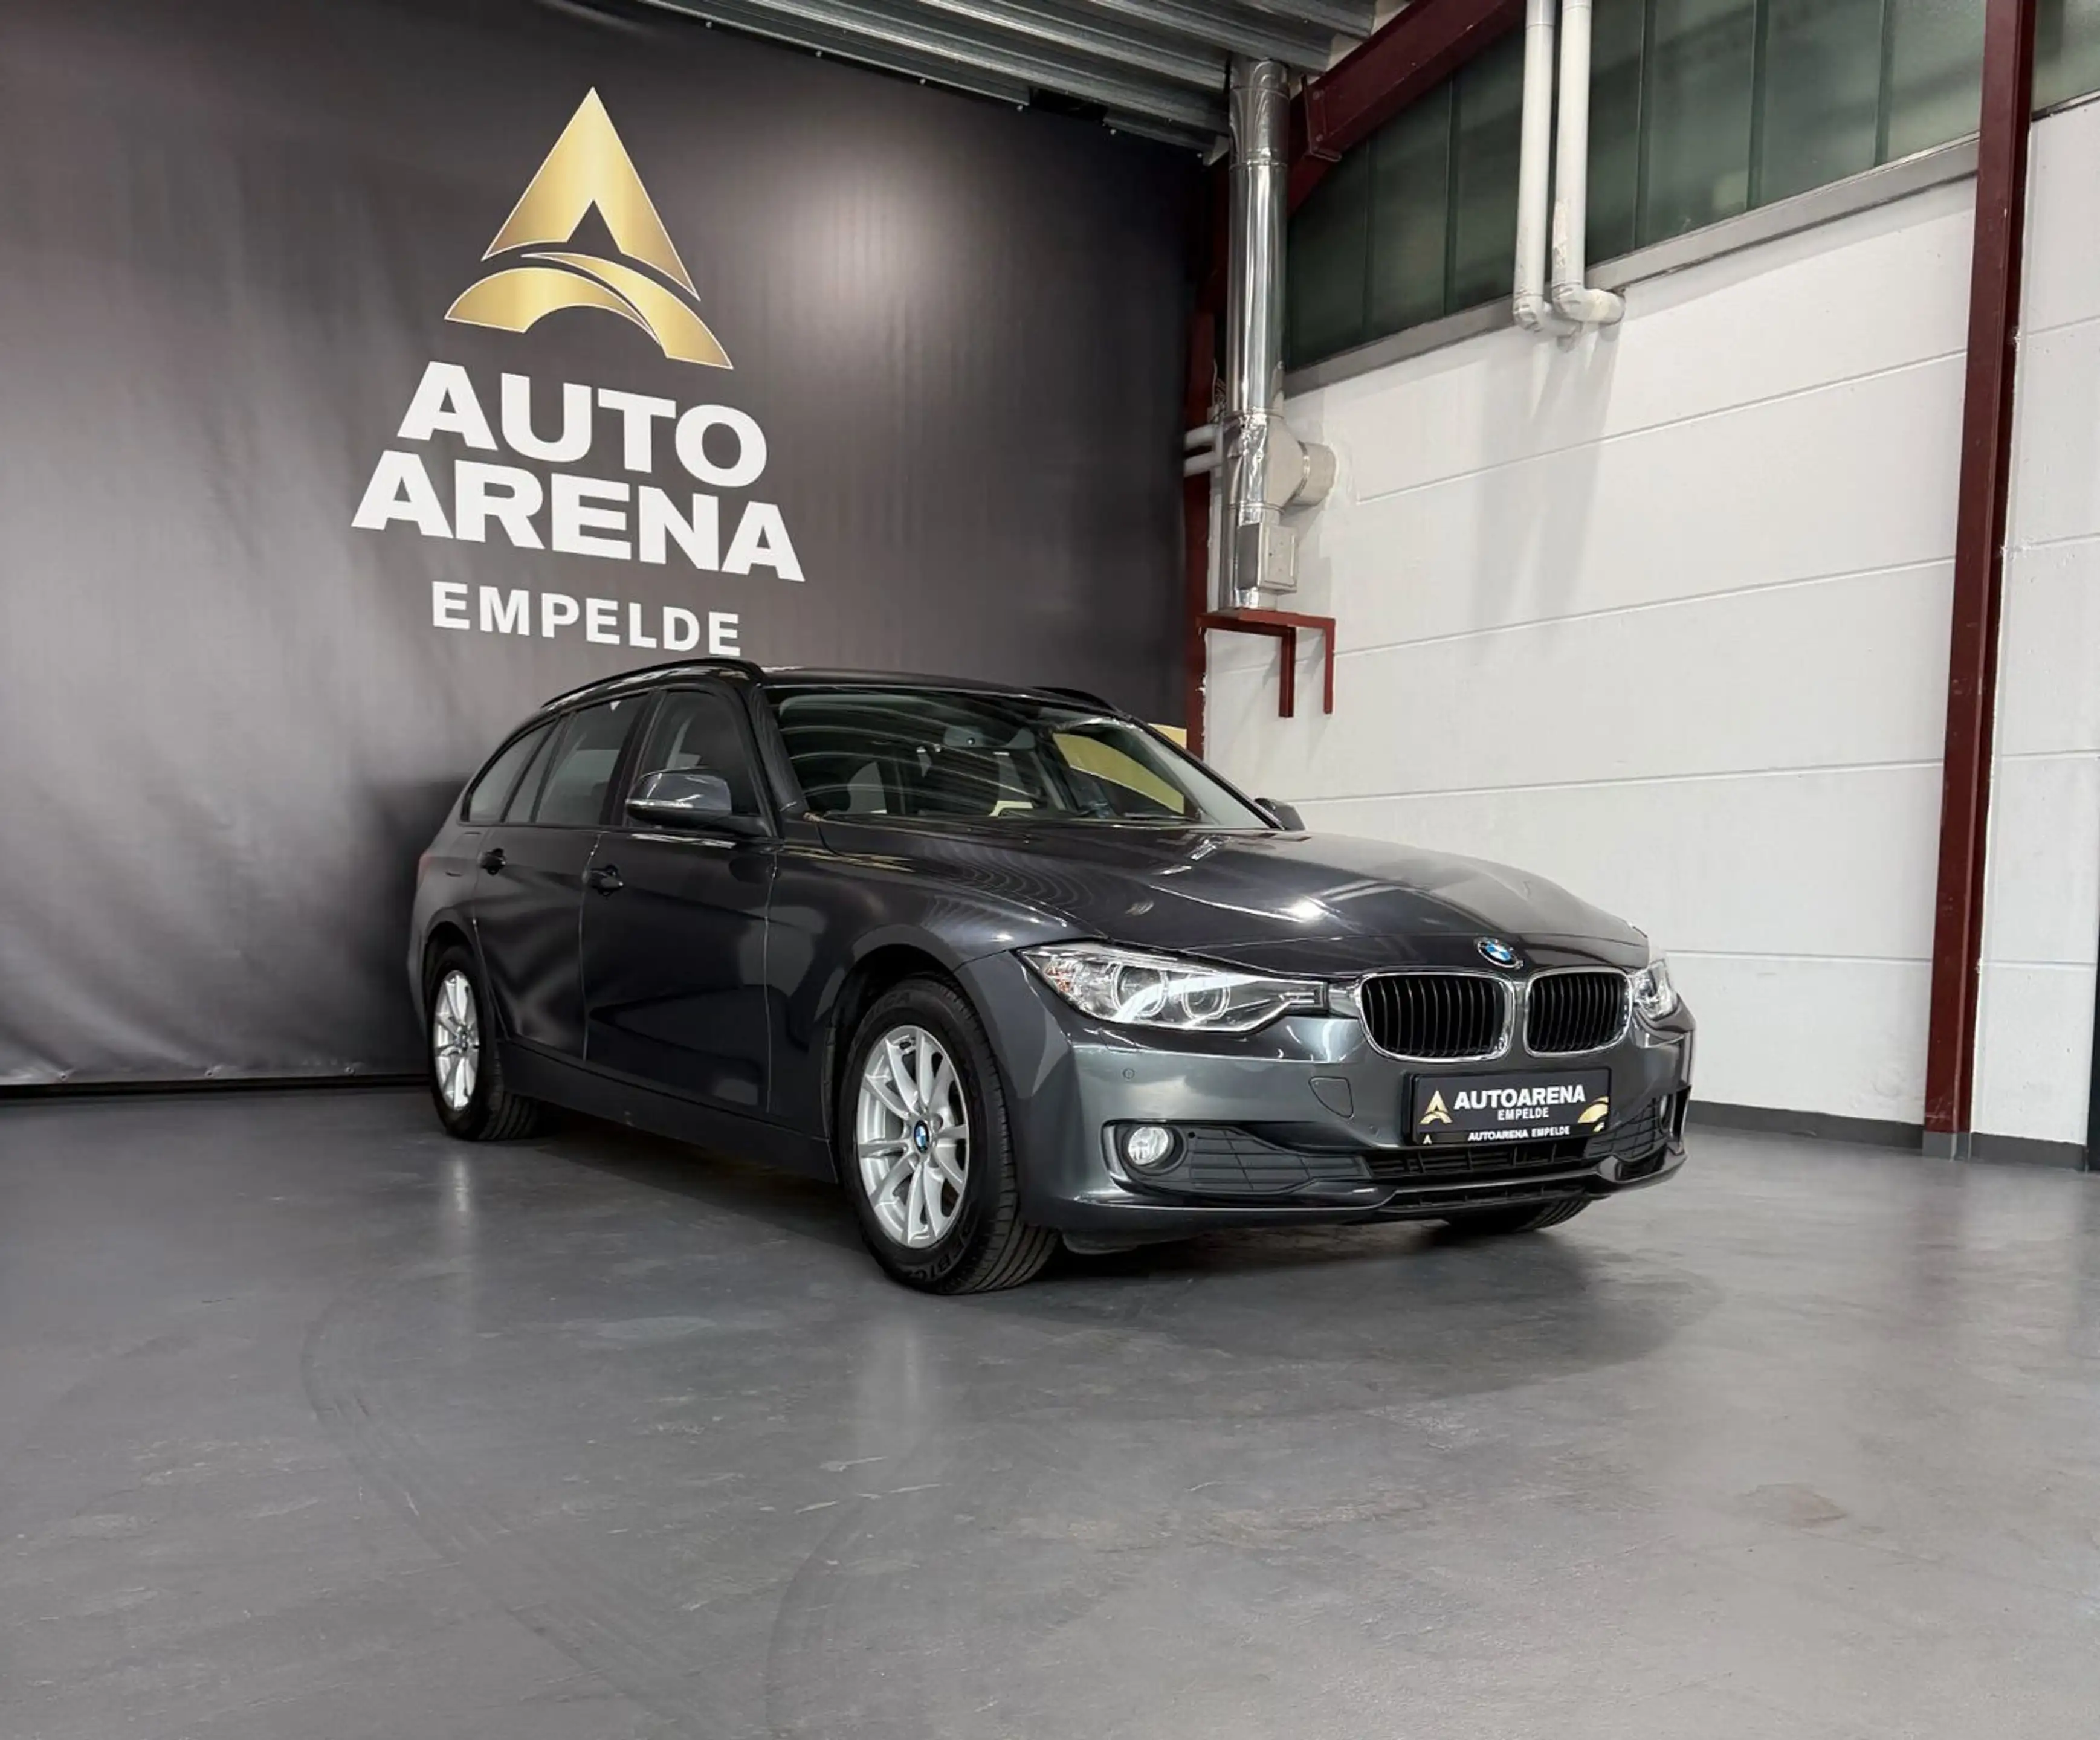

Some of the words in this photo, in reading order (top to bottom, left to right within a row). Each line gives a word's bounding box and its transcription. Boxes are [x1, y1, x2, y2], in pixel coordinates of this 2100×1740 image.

[397, 361, 767, 487] AUTO
[351, 450, 804, 582] ARENA
[432, 581, 740, 656] EMPELDE
[1453, 1084, 1586, 1110] AUTOARENA
[1497, 1107, 1549, 1121] EMPELDE
[1468, 1129, 1529, 1141] AUTOARENA
[1531, 1125, 1570, 1138] EMPELDE
